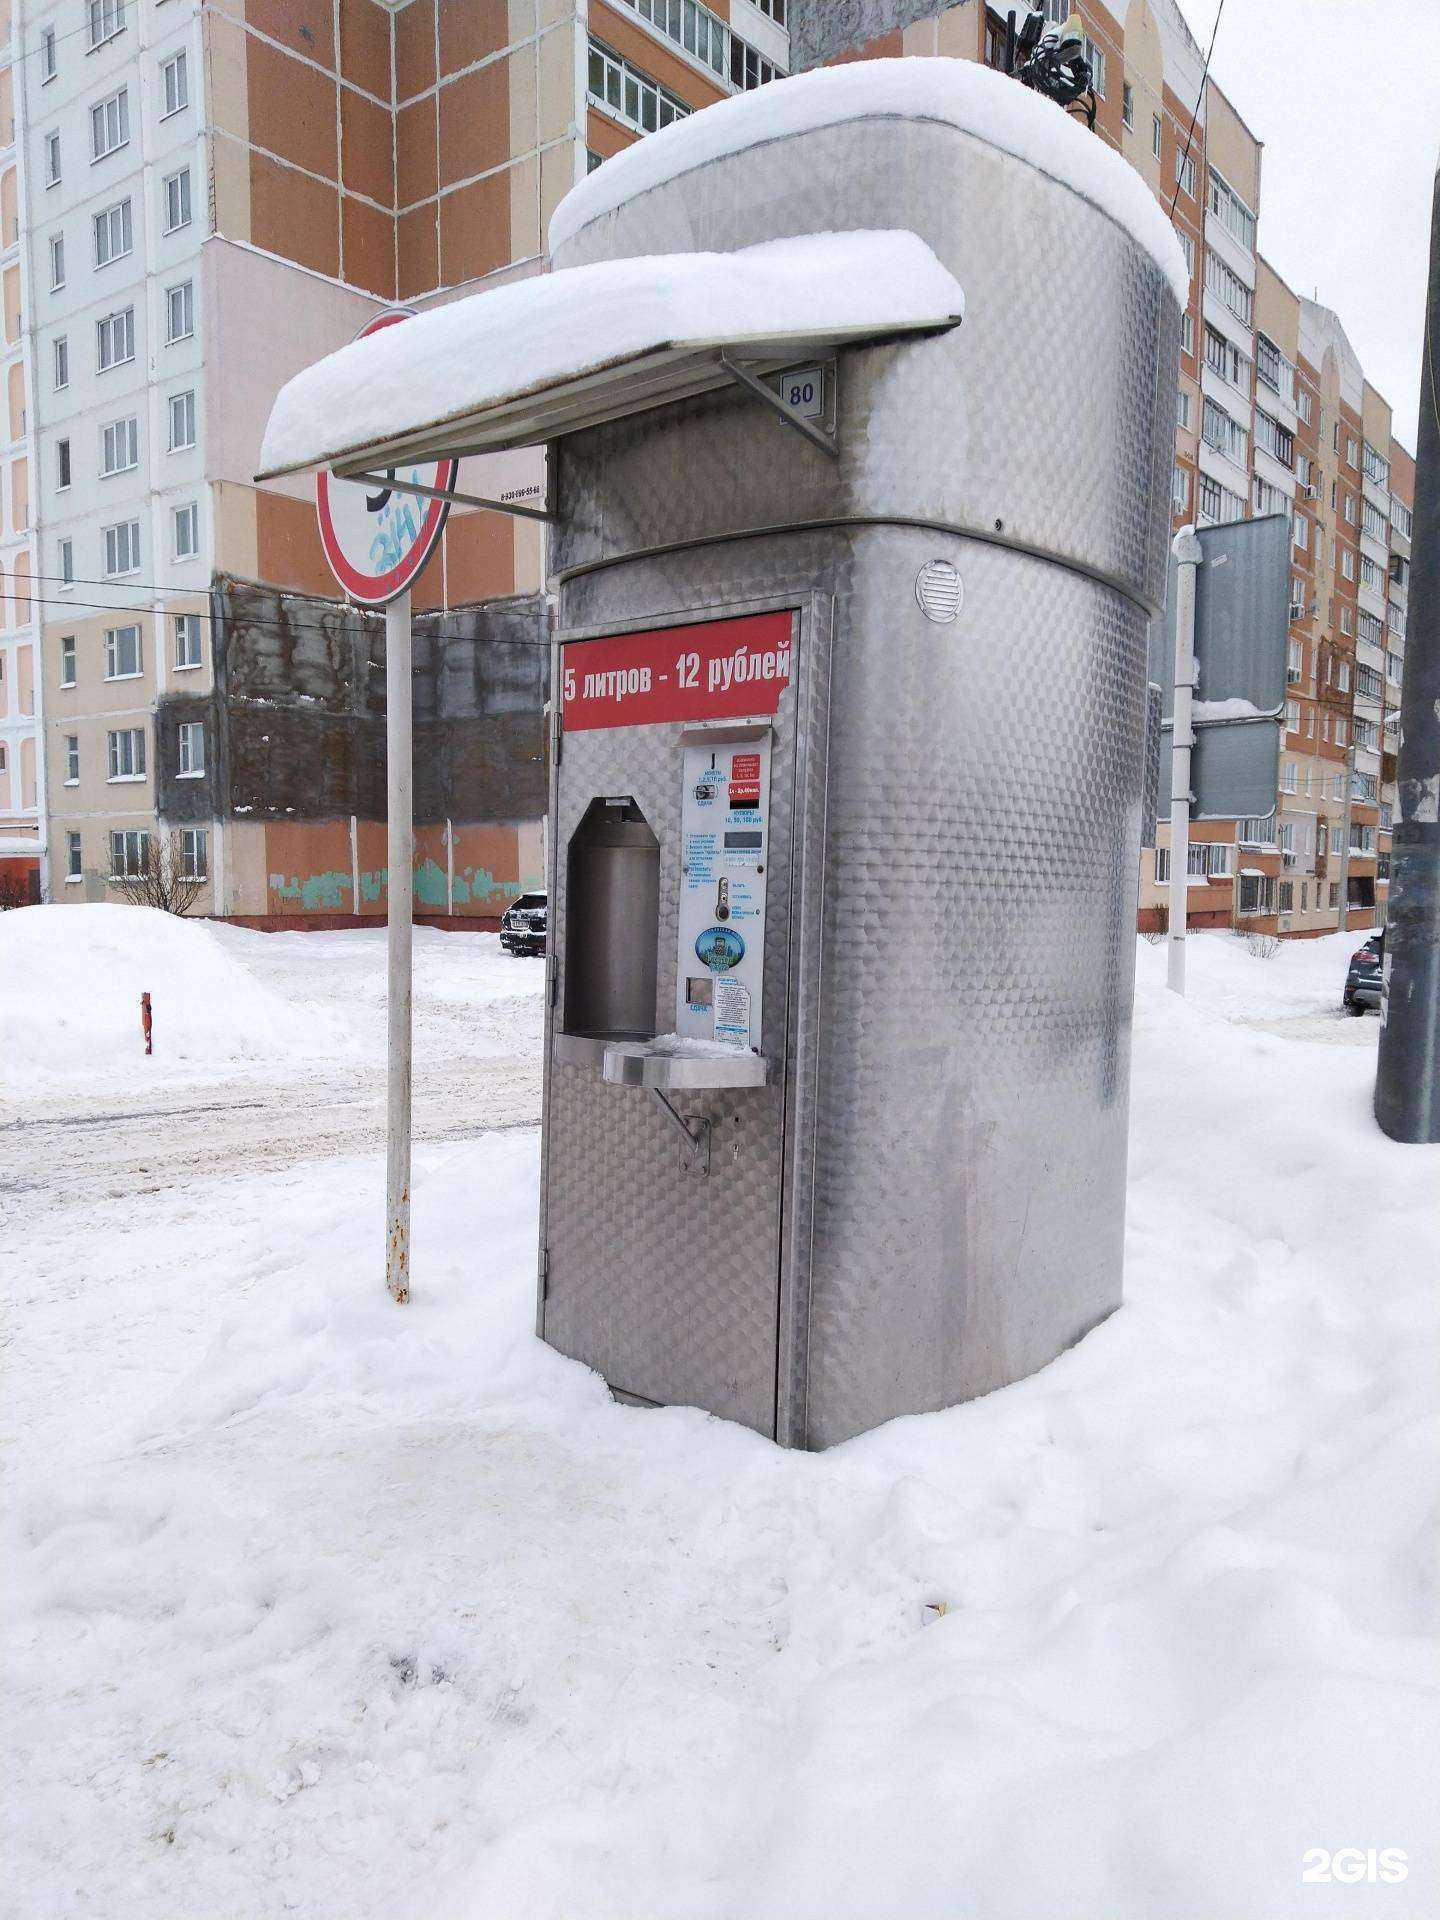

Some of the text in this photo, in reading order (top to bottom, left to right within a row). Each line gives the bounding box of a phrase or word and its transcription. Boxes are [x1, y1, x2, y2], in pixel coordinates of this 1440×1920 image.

[790, 383, 814, 406] 80
[563, 668, 576, 701] 5
[582, 666, 652, 702] литров
[675, 652, 700, 689] 12
[707, 640, 791, 693] рублей
